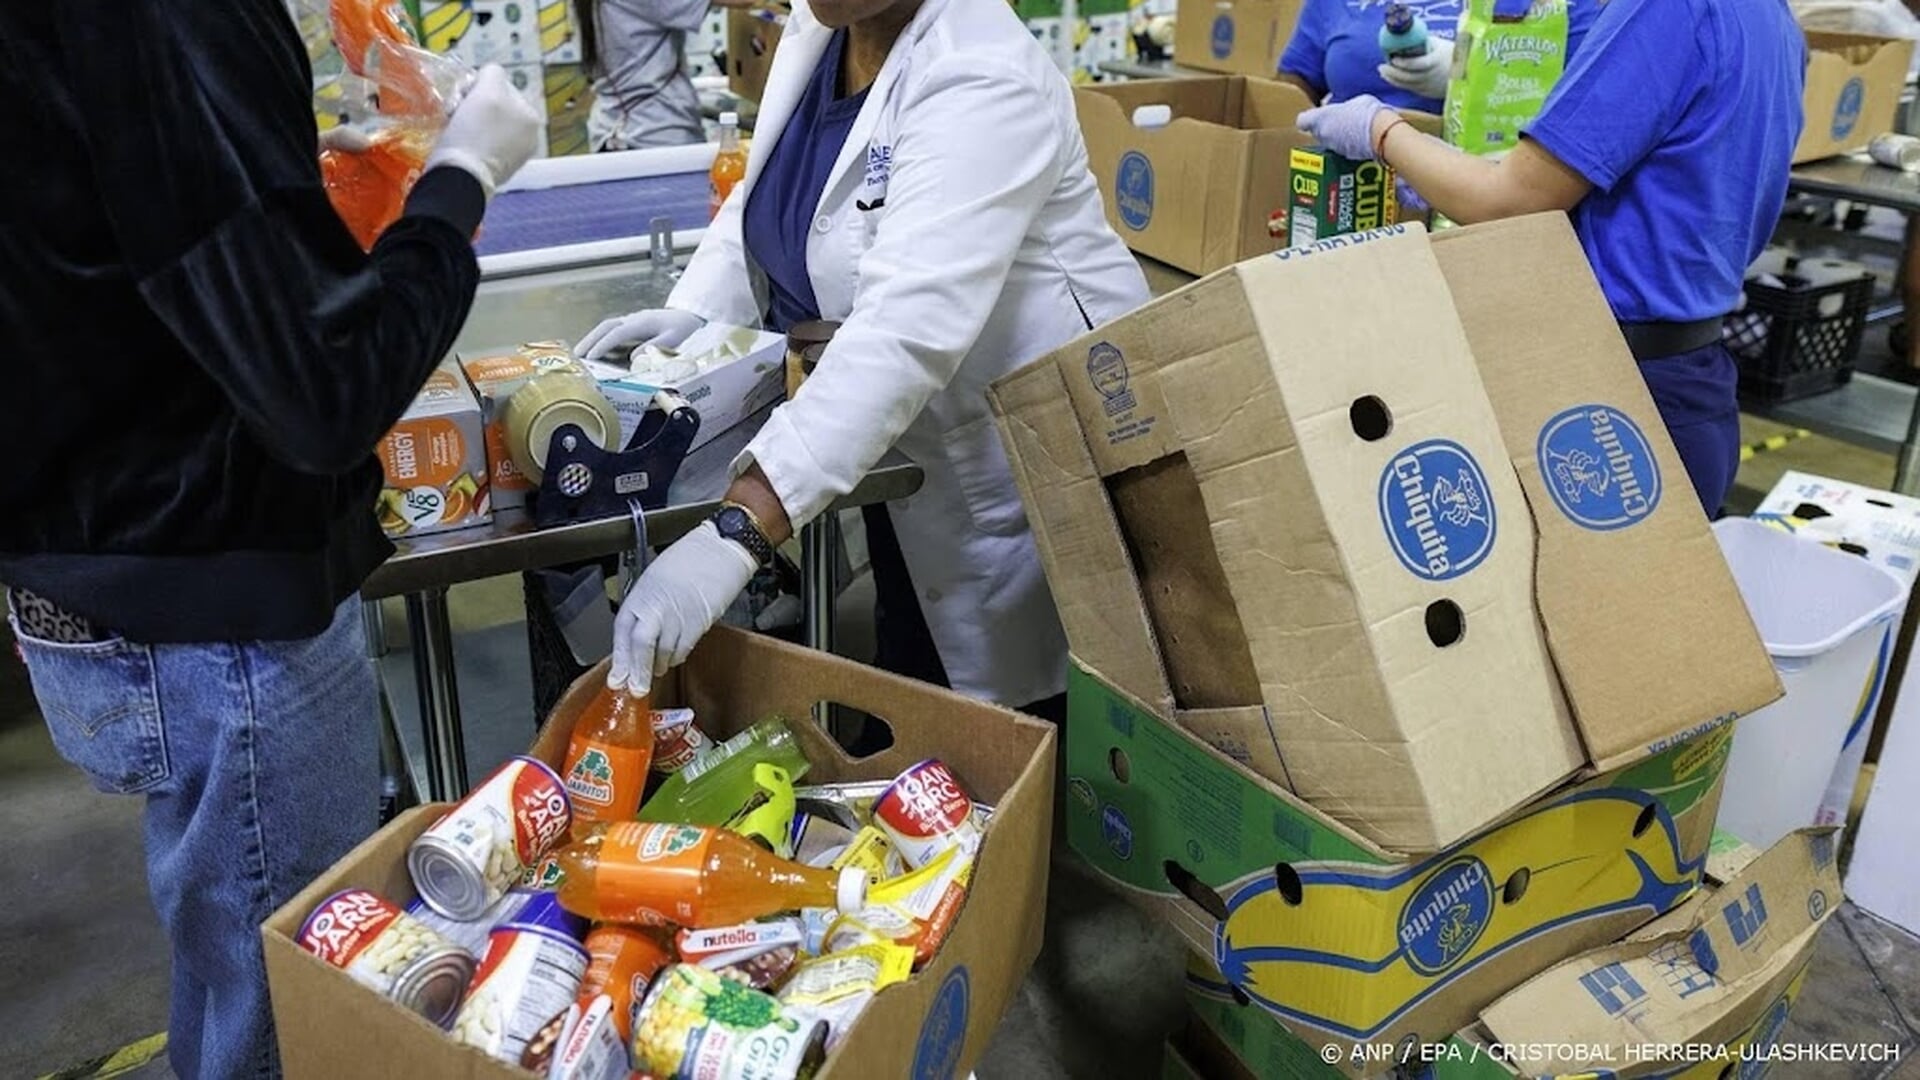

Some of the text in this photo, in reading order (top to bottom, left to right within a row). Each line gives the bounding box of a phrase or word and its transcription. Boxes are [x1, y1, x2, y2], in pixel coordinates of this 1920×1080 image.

[1293, 173, 1320, 197] CLUB
[1355, 160, 1383, 232] CLUB
[393, 431, 418, 479] ENERGY
[1590, 408, 1649, 518] Chiquita
[407, 494, 440, 522] V8
[1394, 454, 1450, 578] Chiquita
[894, 765, 953, 815] JOAN
[305, 892, 379, 957] JOAN
[1400, 861, 1485, 944] Chiquita
[327, 904, 388, 953] ARC
[703, 928, 757, 948] nutella
